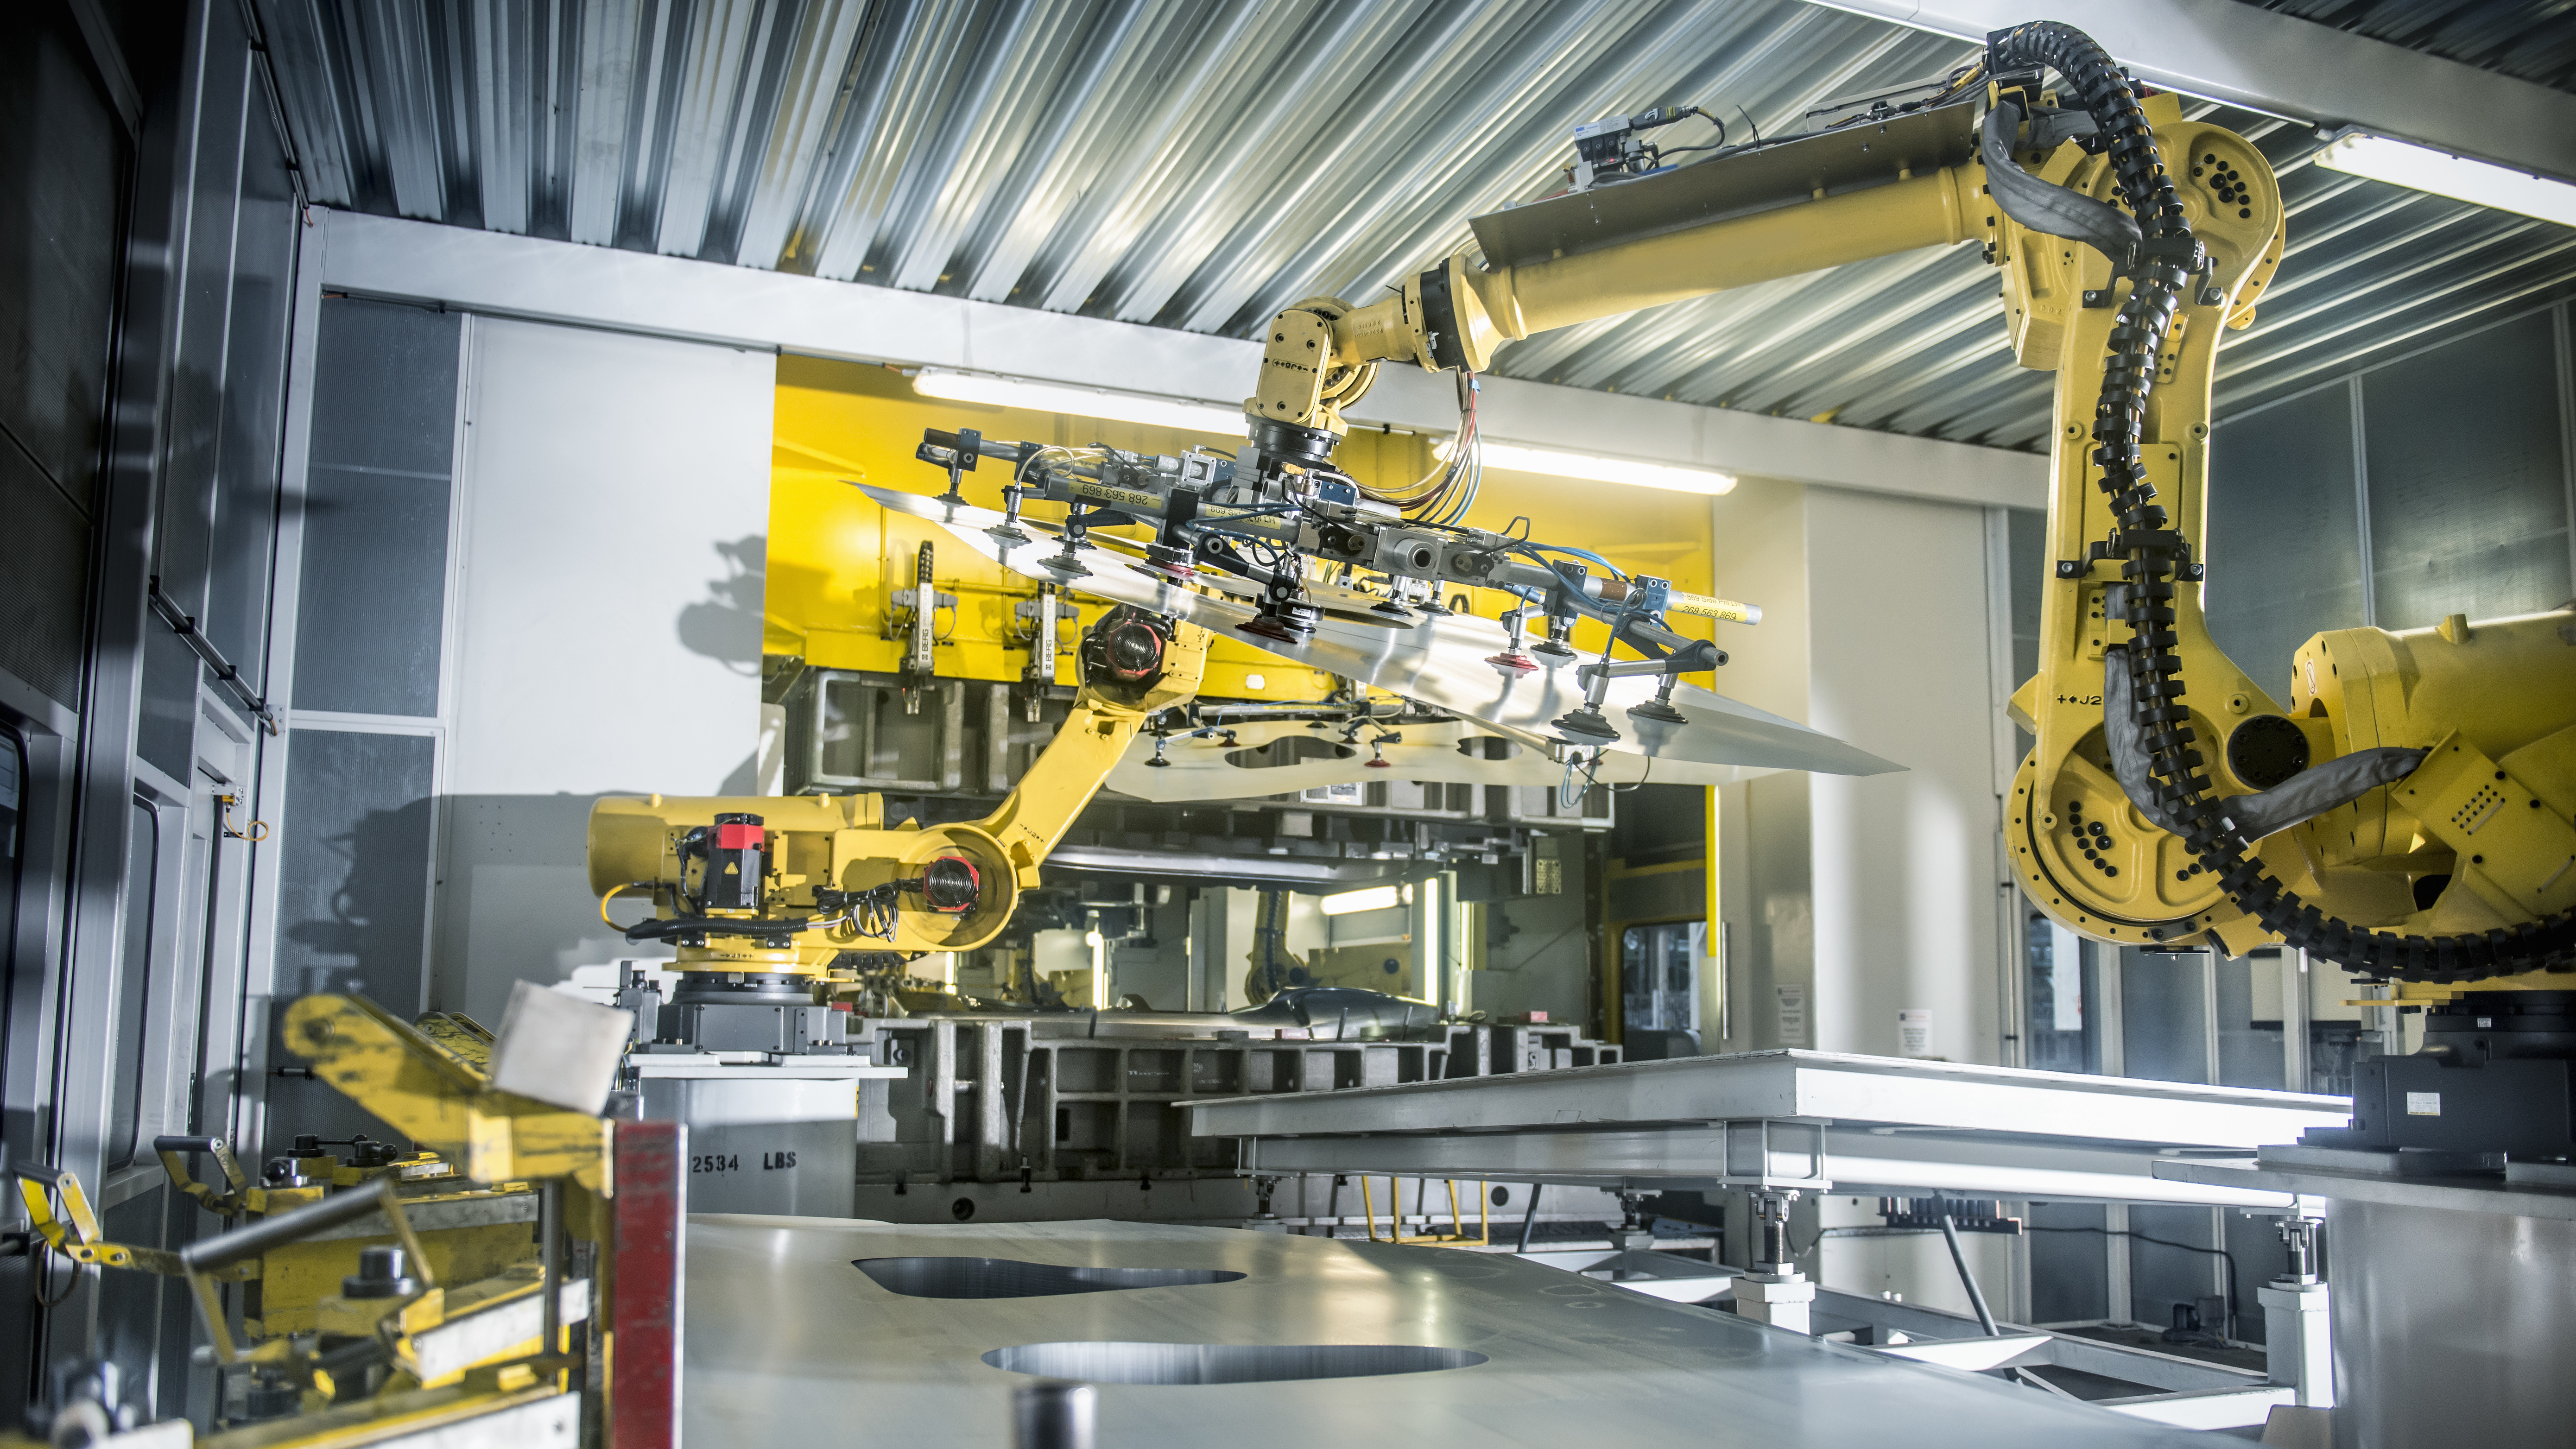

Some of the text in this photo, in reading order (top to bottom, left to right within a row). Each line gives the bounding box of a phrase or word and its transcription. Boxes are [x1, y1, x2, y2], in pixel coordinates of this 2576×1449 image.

[1082, 485, 1148, 505] 268 563 869
[1210, 506, 1226, 514] 869
[1264, 516, 1275, 524] LH
[1682, 606, 1737, 620] 268 563 869
[2079, 696, 2102, 705] J2
[764, 1151, 797, 1170] LBS
